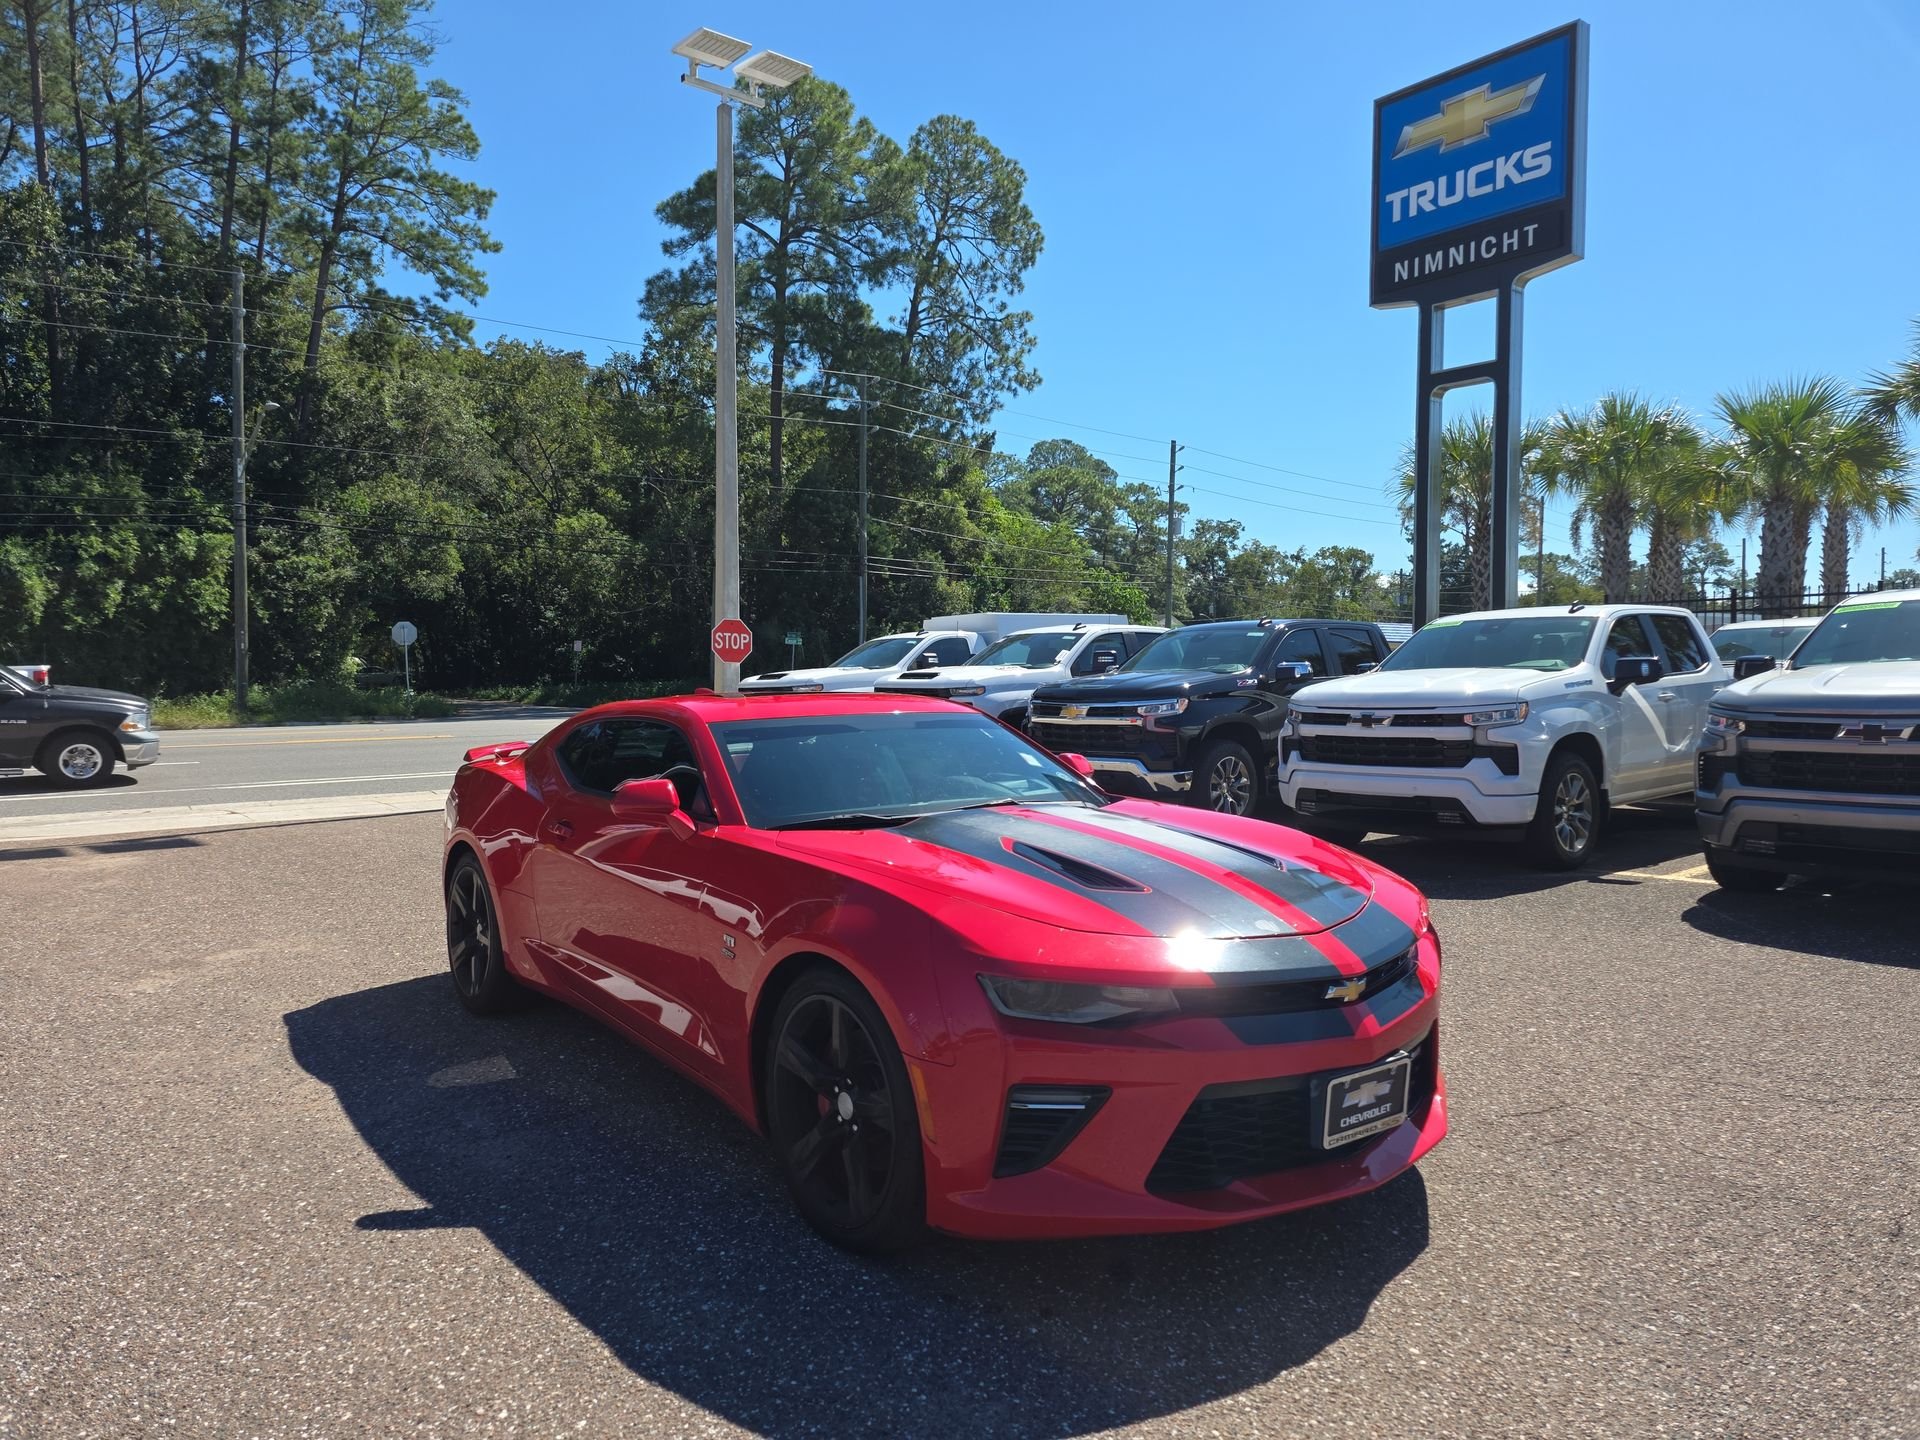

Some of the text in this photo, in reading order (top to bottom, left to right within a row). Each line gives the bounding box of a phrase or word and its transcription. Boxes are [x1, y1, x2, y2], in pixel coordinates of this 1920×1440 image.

[1385, 141, 1552, 223] TRUCKS
[1394, 224, 1539, 283] NIMNICHT
[714, 632, 750, 650] STOP
[1340, 1102, 1392, 1128] CHEVROLET
